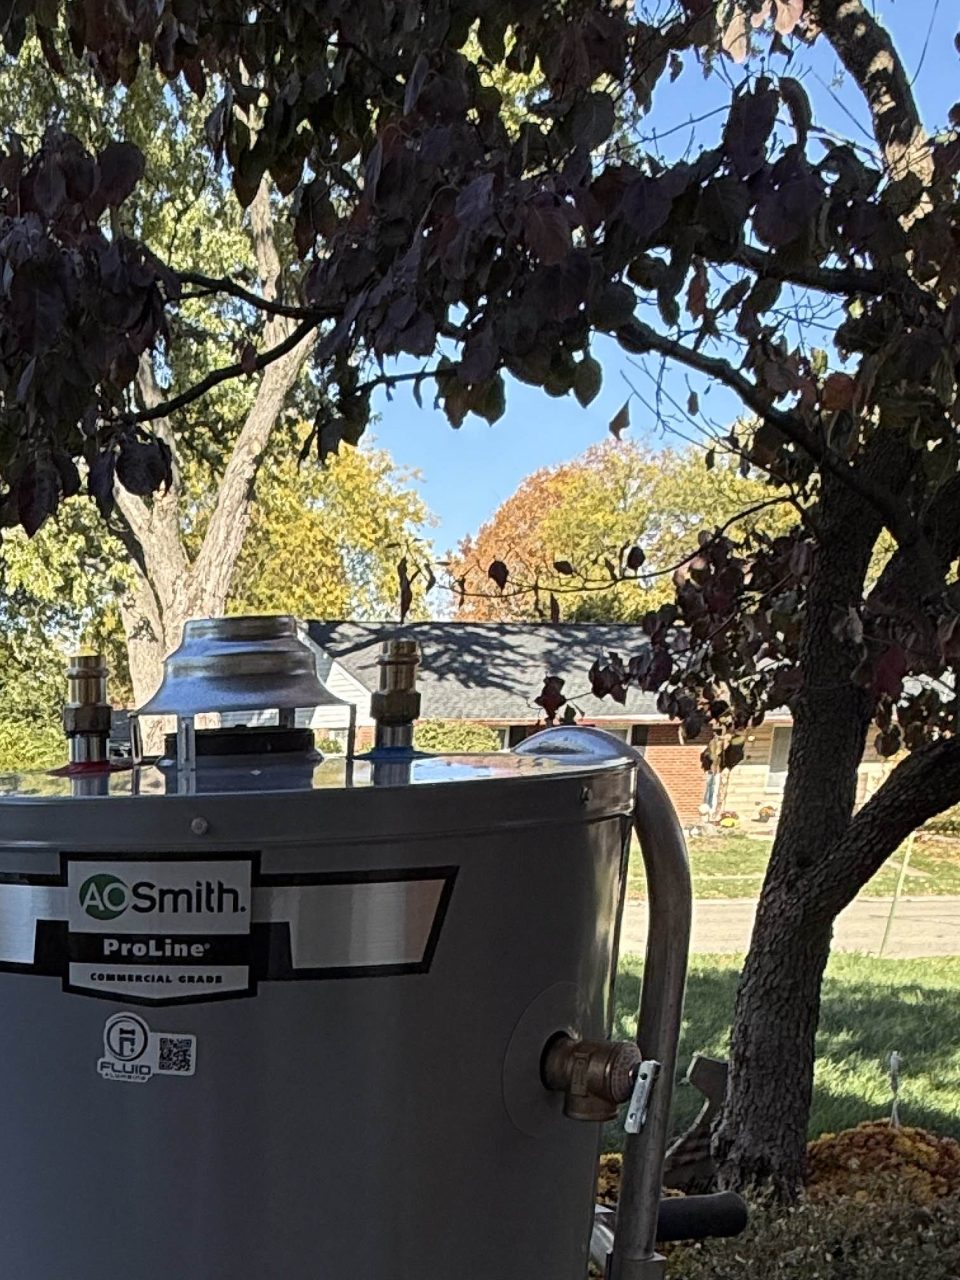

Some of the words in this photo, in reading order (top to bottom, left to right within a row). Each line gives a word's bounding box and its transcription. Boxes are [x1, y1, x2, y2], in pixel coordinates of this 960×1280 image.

[90, 972, 173, 983] COMMERCIAL
[178, 975, 223, 984] GRADE
[100, 1061, 152, 1076] FLUID
